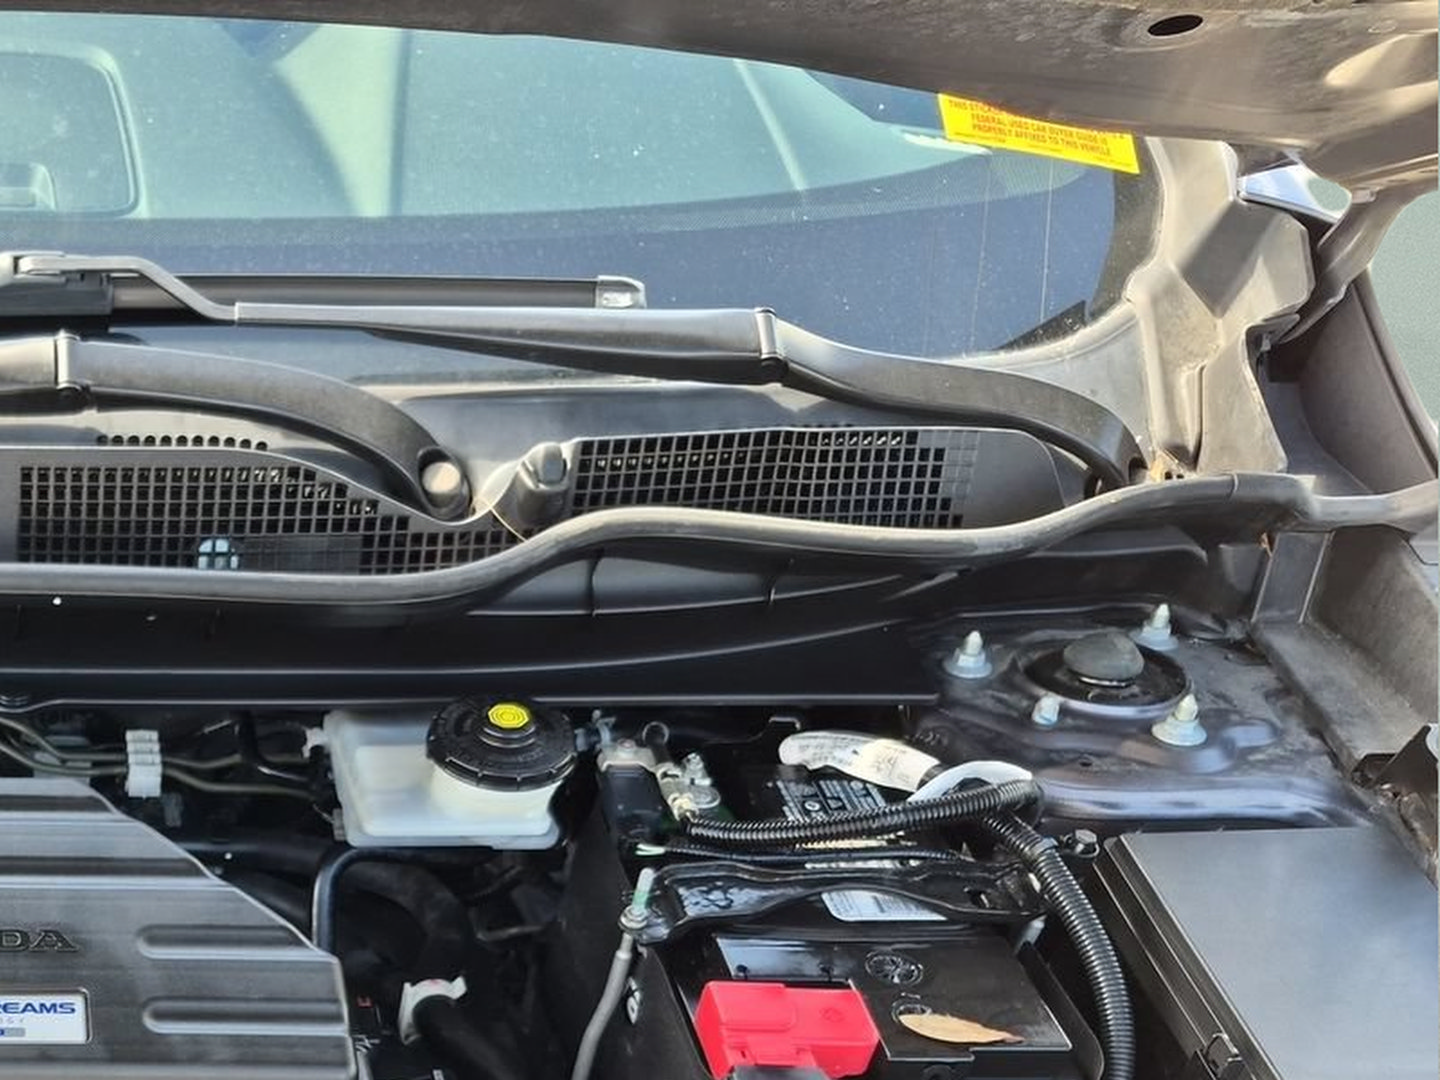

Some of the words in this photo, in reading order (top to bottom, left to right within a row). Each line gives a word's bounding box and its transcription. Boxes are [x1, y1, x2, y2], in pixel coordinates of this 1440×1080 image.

[971, 113, 1006, 128] FEDERAL
[1008, 117, 1030, 130] USED
[1031, 122, 1047, 133] CAR
[972, 123, 1013, 138] PROPERLY
[1014, 130, 1046, 144] AFFIXED
[1048, 134, 1061, 145] TO
[1062, 136, 1079, 149] THIS
